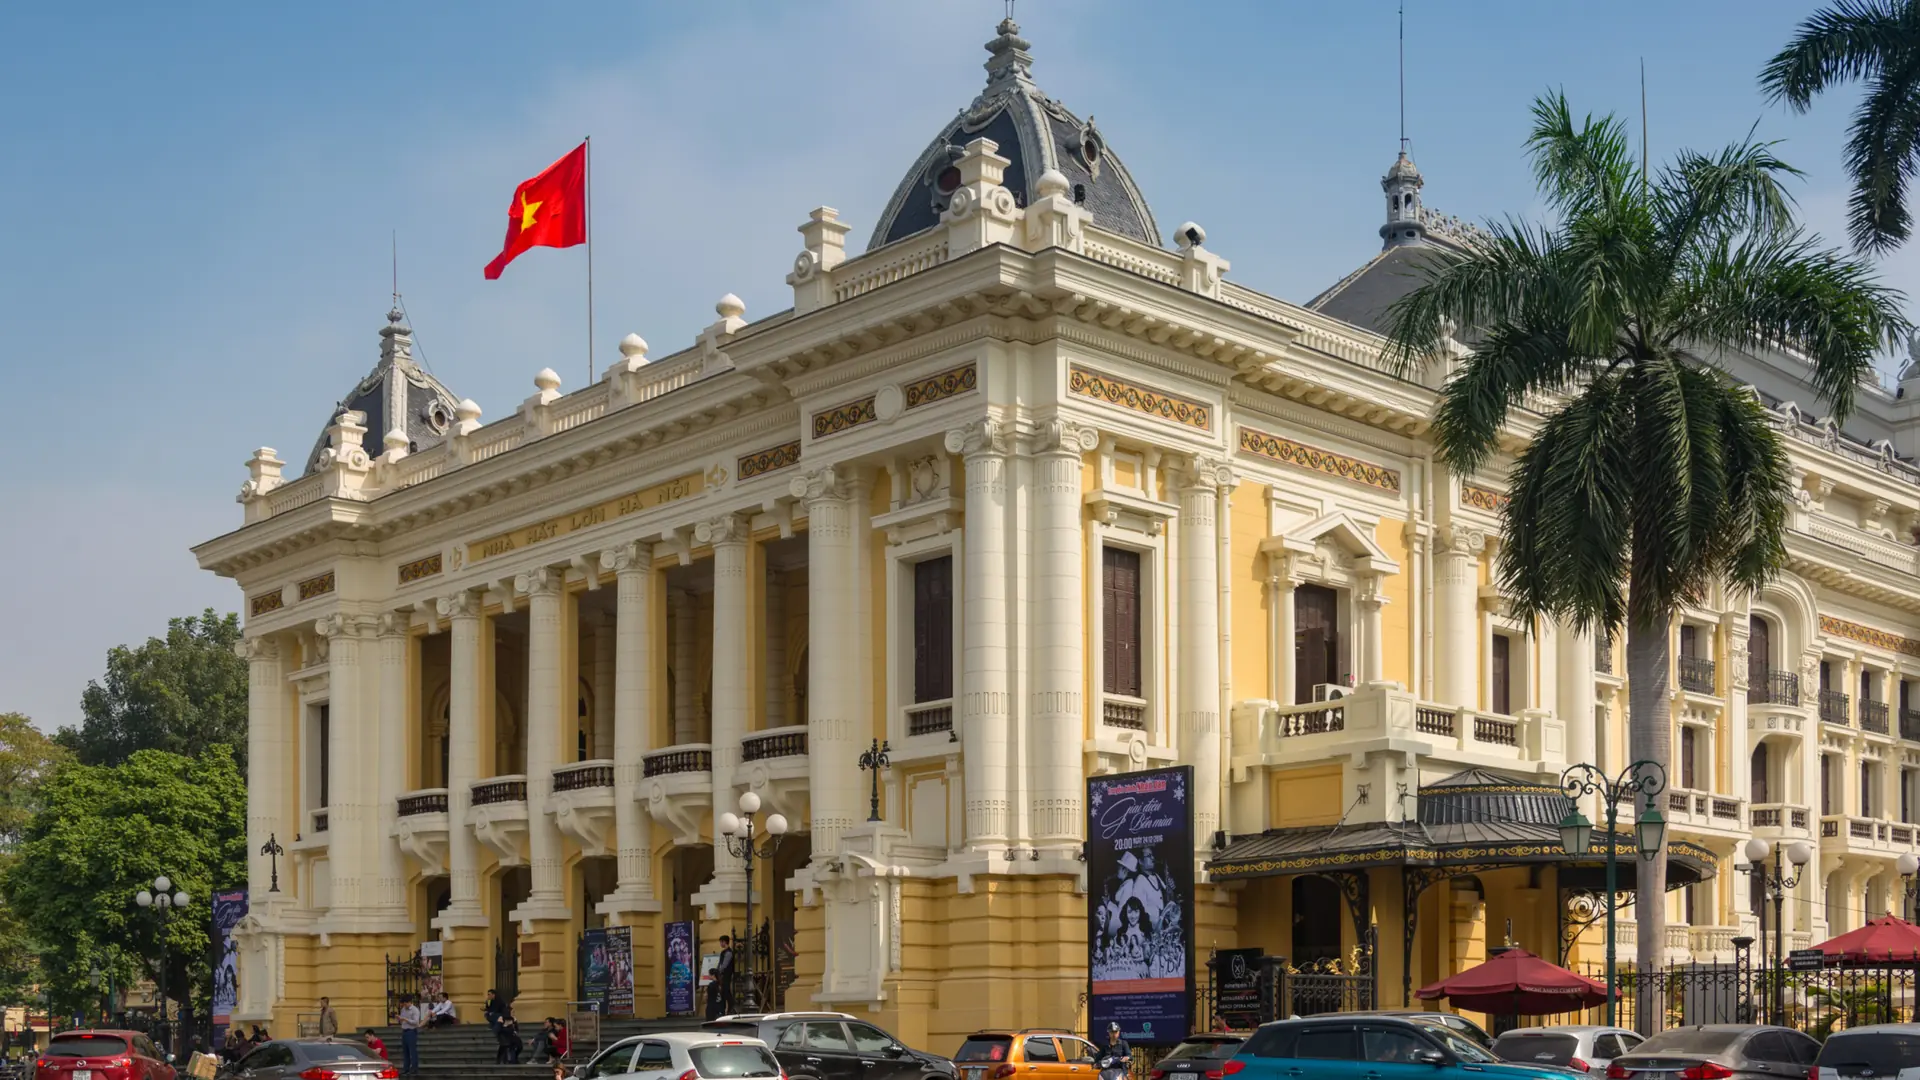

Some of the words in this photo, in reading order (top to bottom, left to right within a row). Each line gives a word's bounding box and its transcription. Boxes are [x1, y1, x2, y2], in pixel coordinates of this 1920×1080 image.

[483, 533, 515, 558] NHÀ
[526, 521, 558, 544] HÁT
[619, 492, 644, 516] HÀ
[657, 479, 690, 504] NỘI
